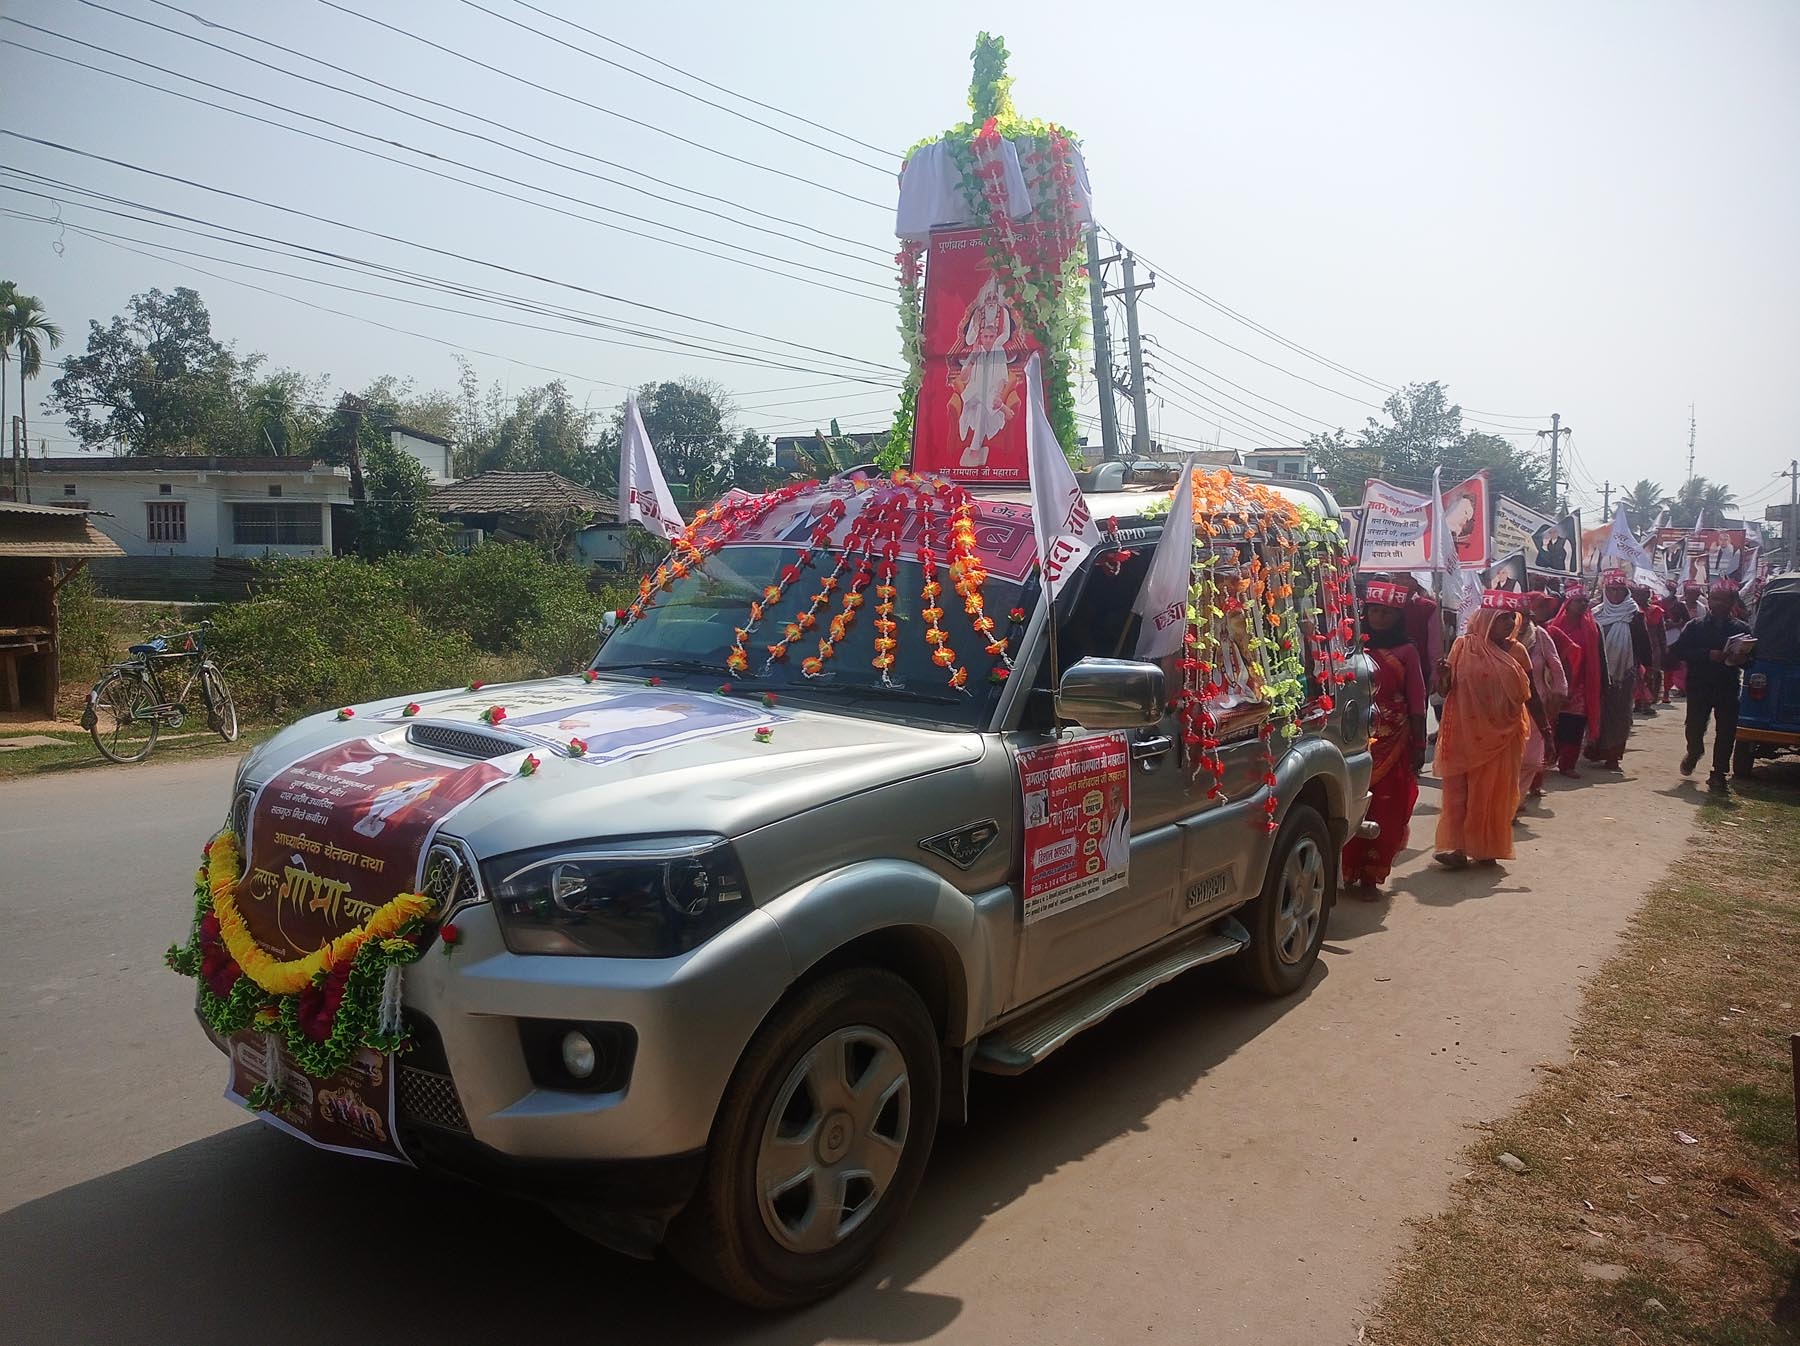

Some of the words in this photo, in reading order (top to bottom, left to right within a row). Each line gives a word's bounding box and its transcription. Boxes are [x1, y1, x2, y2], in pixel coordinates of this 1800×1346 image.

[953, 468, 979, 477] रामपाल
[982, 466, 990, 477] जी
[992, 467, 1019, 477] महाराज
[273, 832, 323, 855] आध्यात्मिक
[324, 841, 360, 866] चेतना
[360, 854, 385, 873] तथा
[343, 897, 381, 921] यात्र
